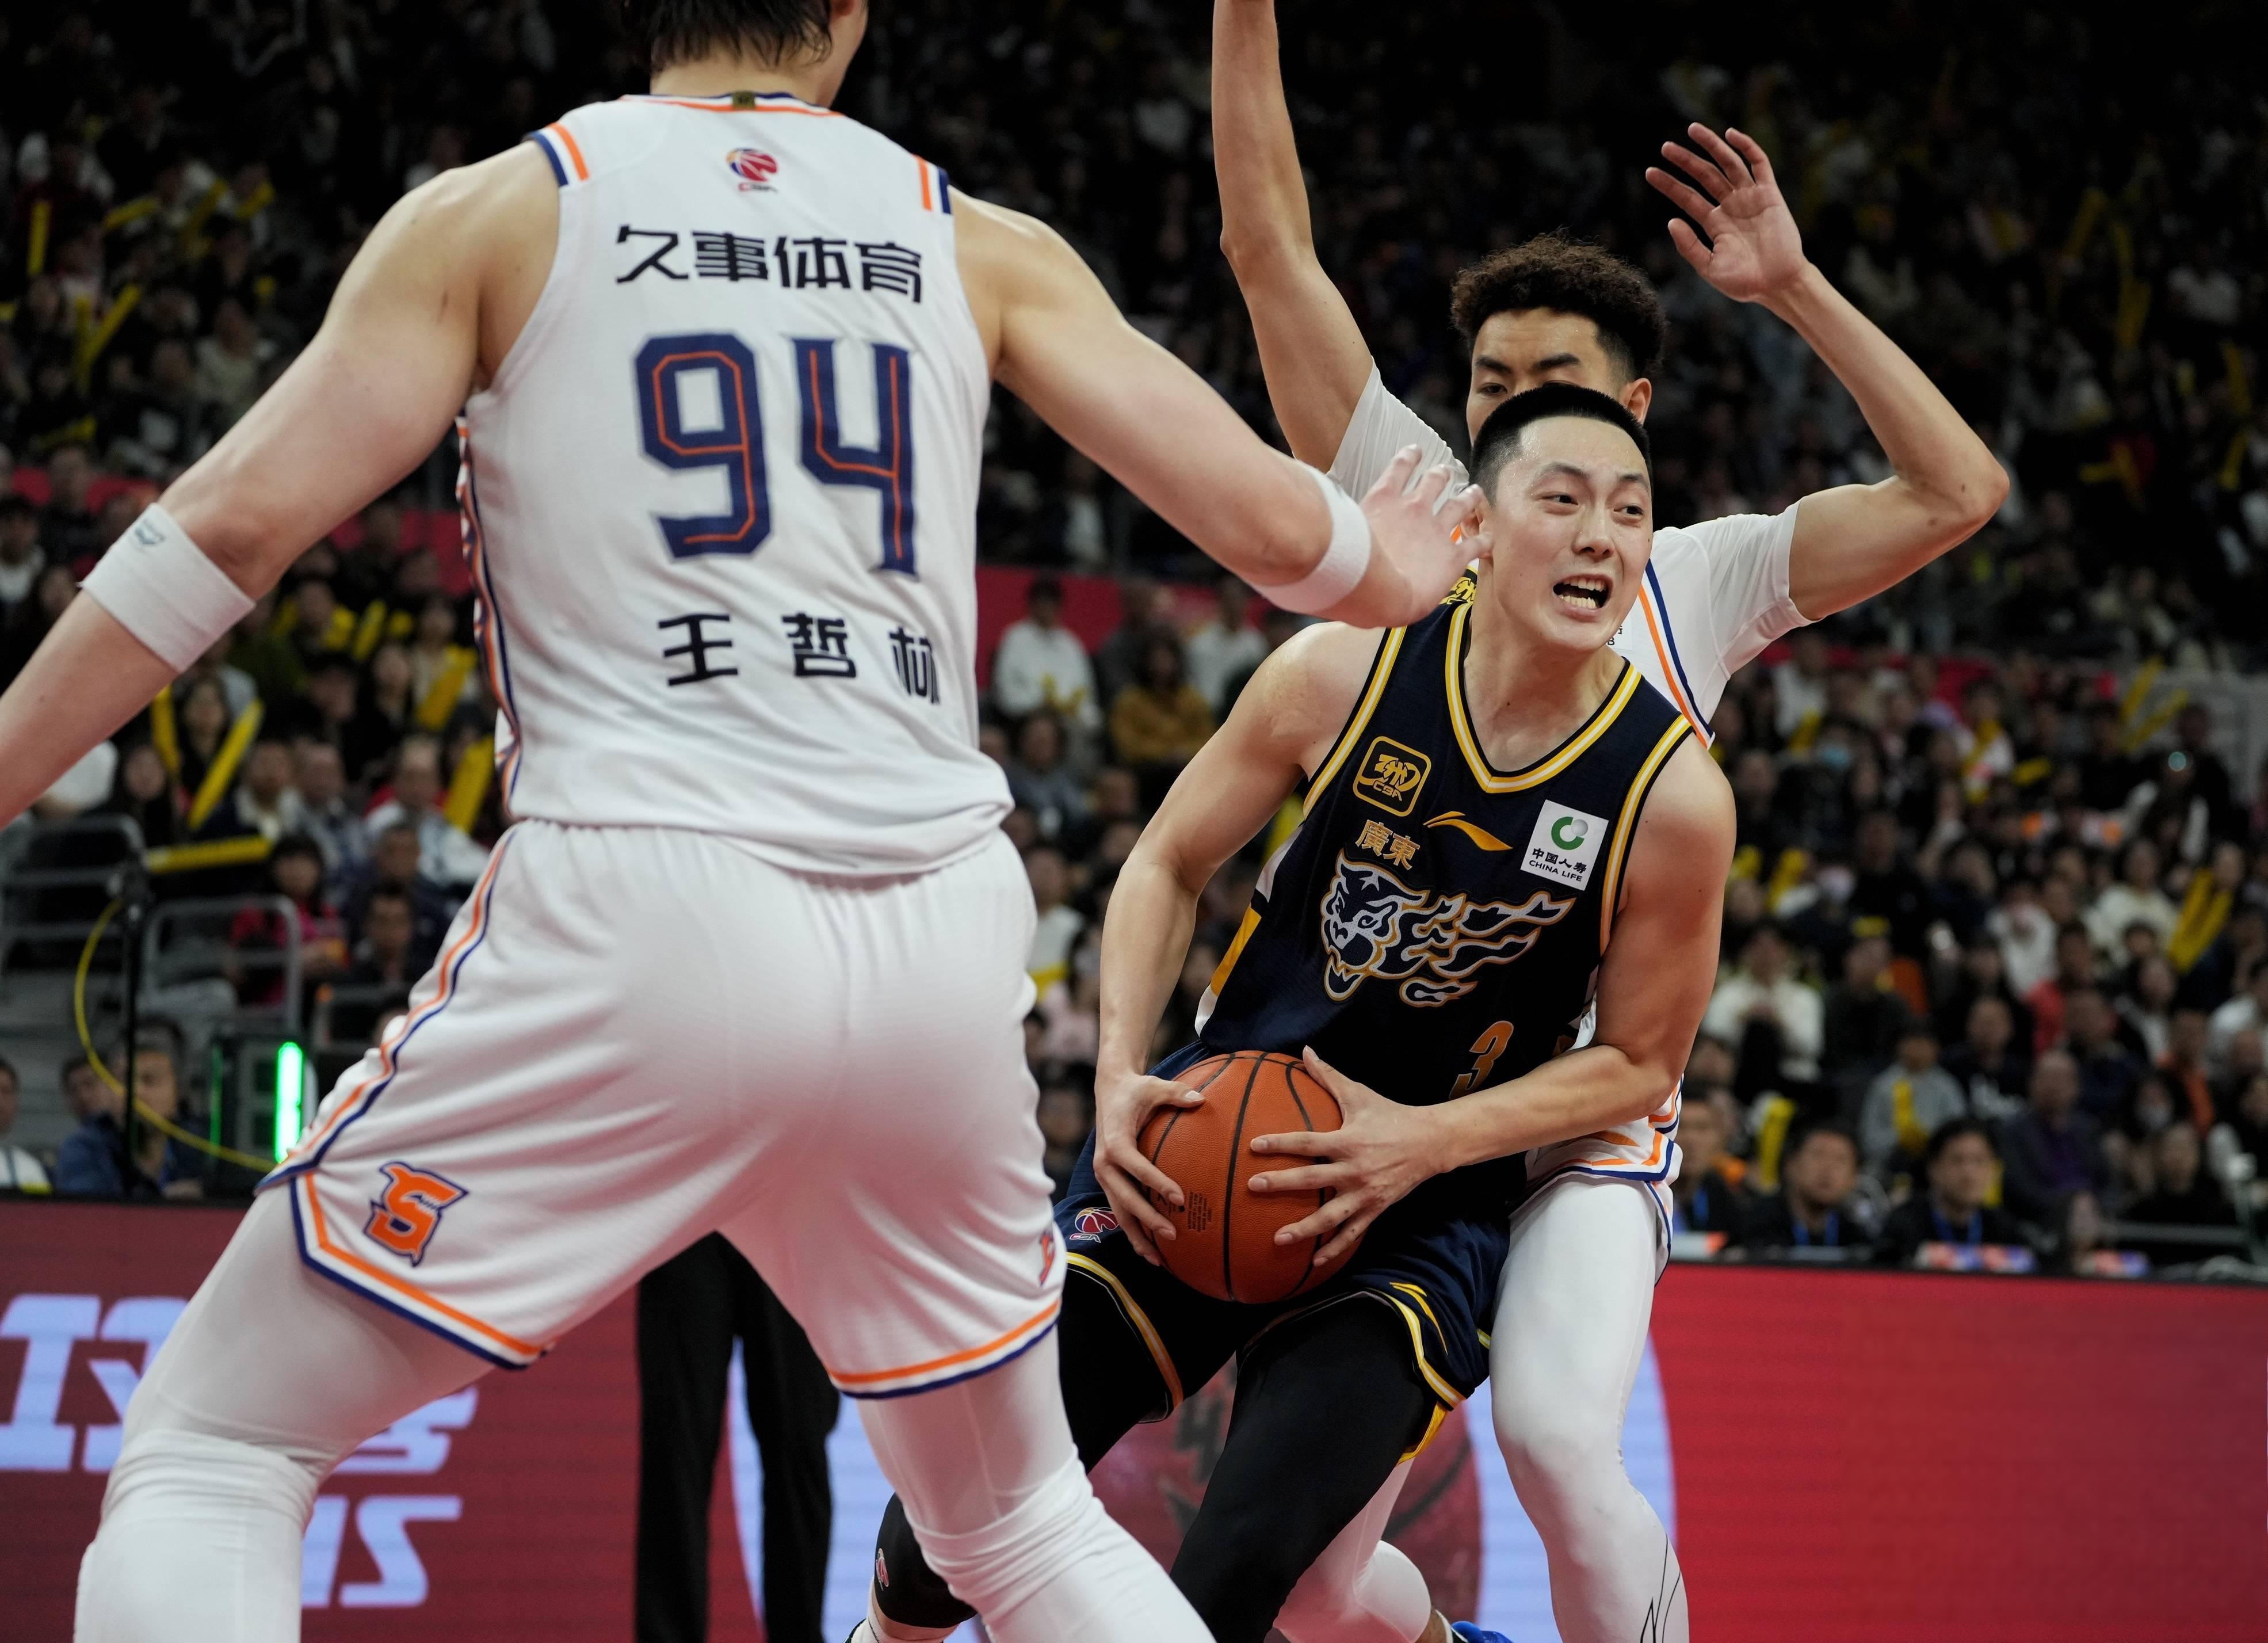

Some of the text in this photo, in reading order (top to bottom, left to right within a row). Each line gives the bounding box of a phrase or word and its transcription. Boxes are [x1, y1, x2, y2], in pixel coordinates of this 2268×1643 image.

[616, 224, 922, 303] 久事体育
[633, 331, 917, 577] 94
[1373, 780, 1403, 802] CBA
[1355, 819, 1421, 870] 廣東
[1532, 848, 1587, 874] 中国人寿
[1529, 860, 1583, 882] CHINA LIFE
